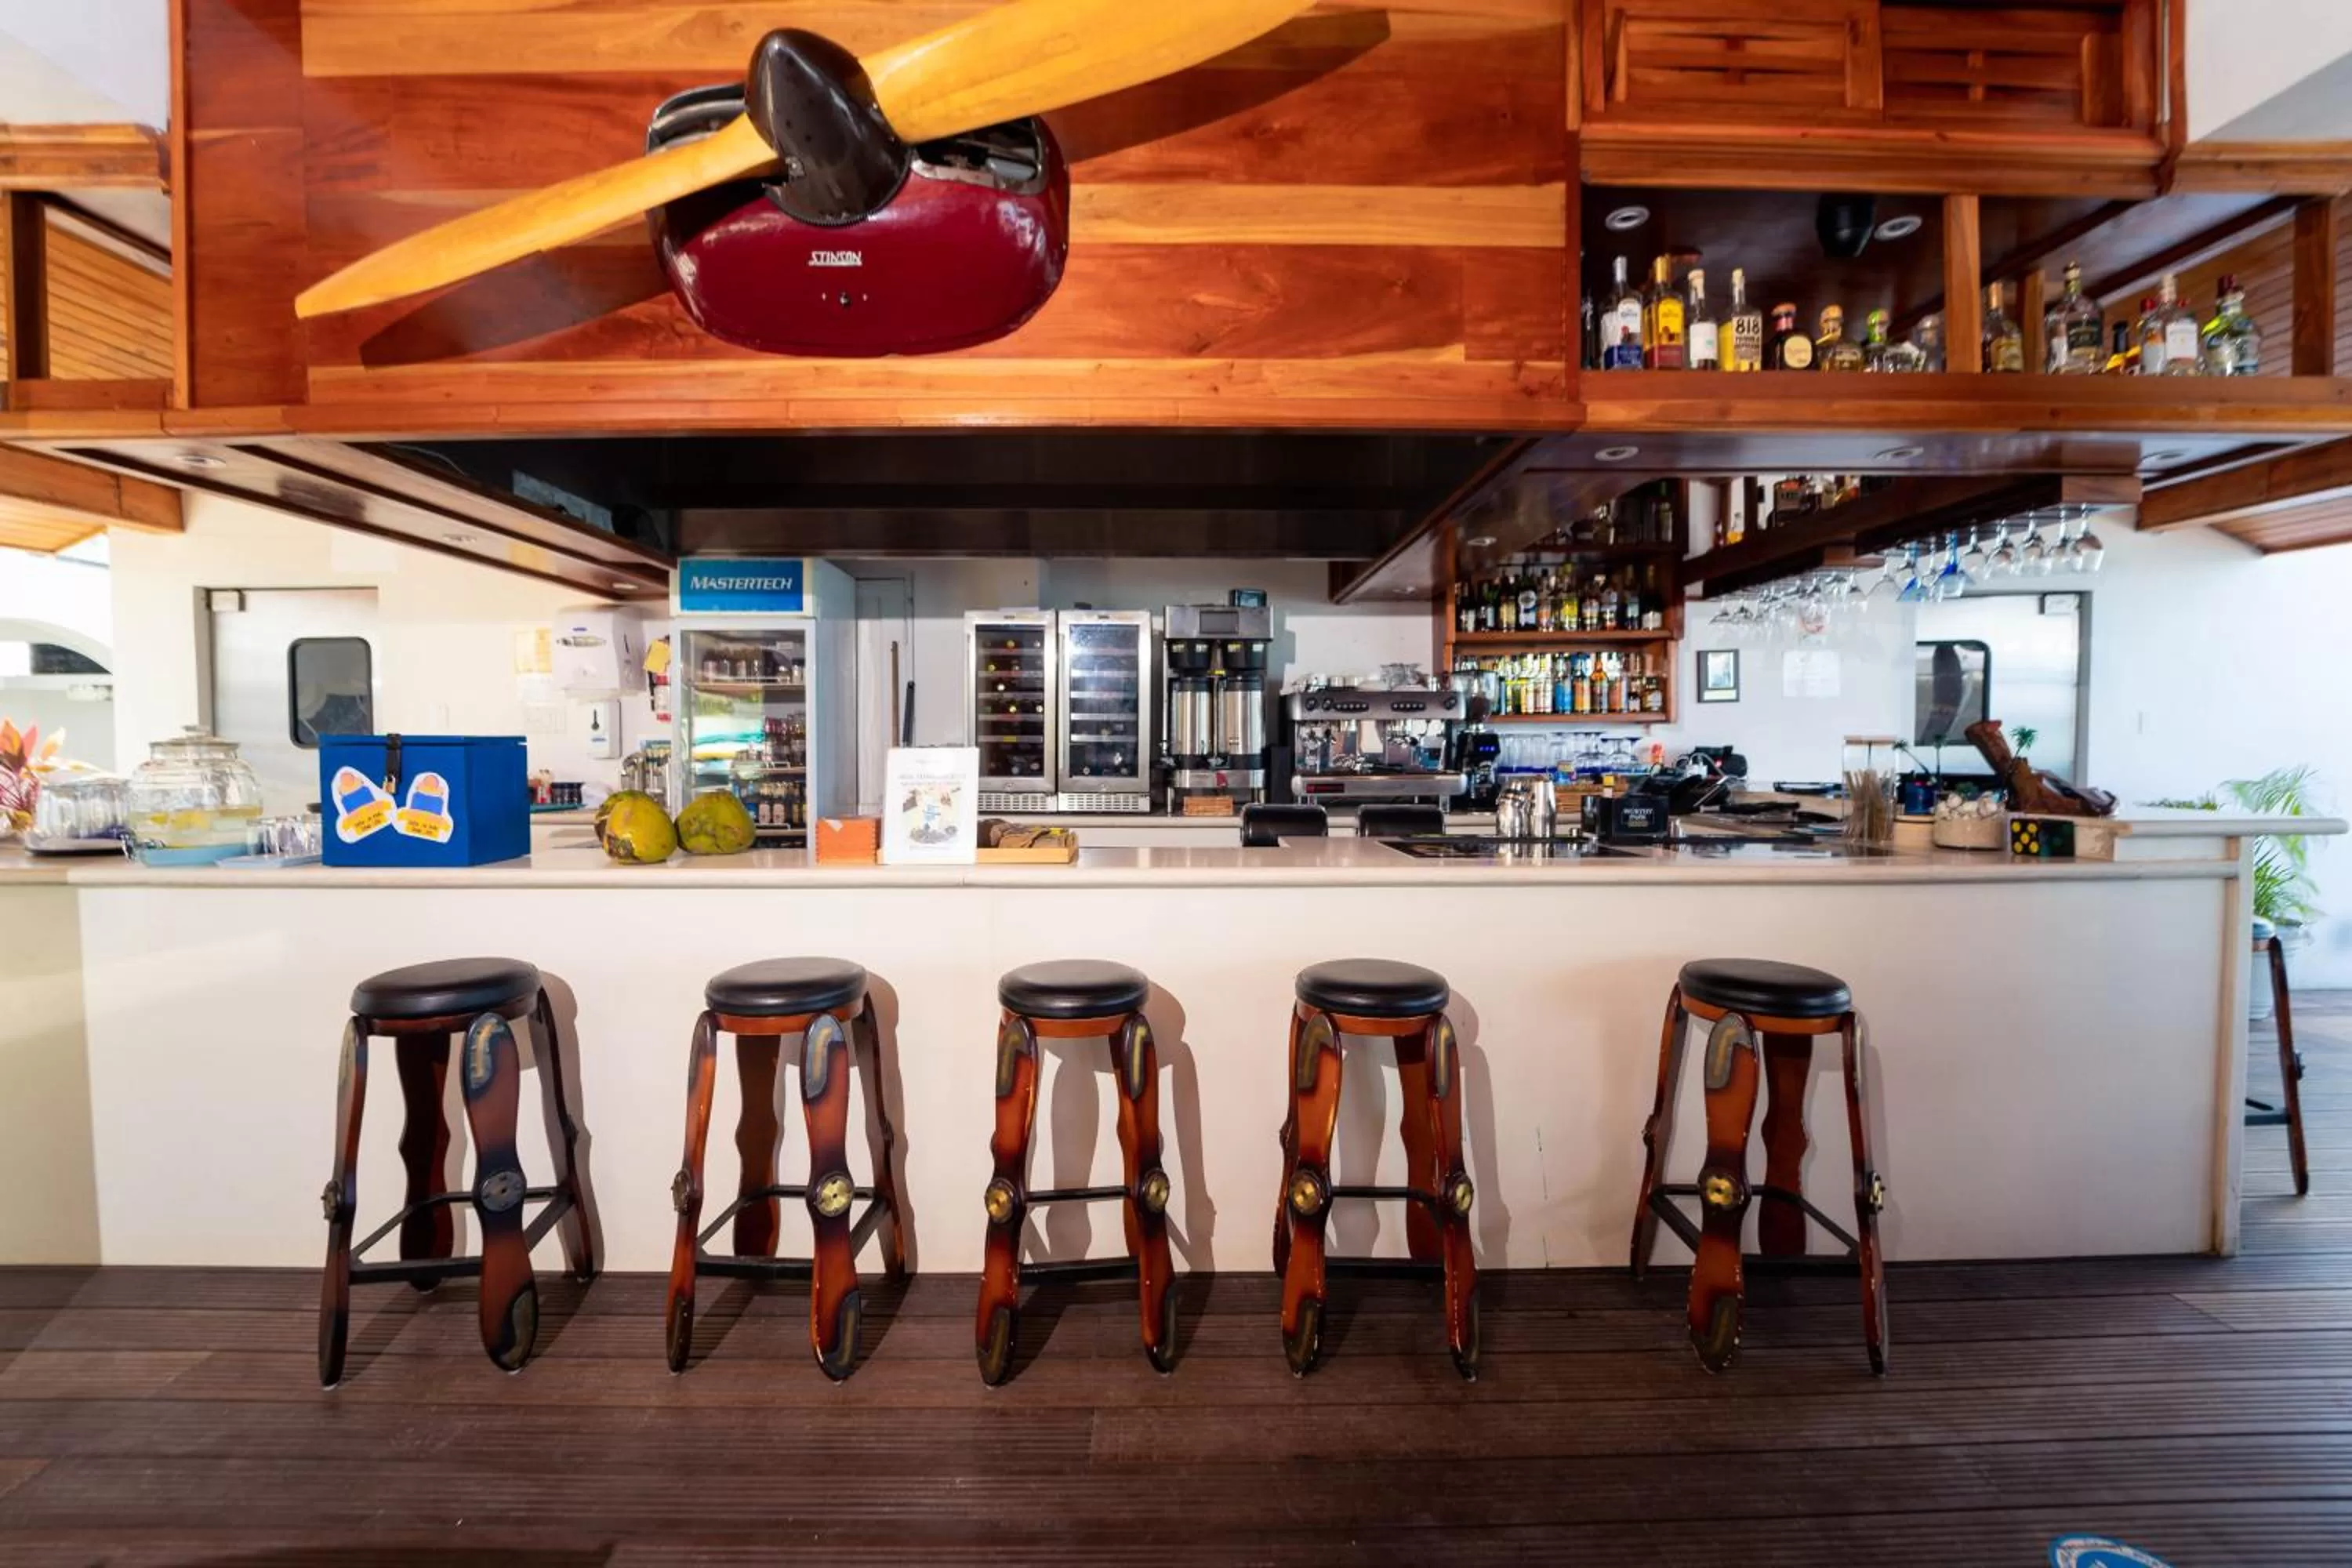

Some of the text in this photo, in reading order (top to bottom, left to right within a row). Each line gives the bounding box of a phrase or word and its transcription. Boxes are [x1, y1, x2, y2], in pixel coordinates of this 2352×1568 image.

[808, 250, 862, 266] STINSON
[1736, 318, 1760, 334] 818
[690, 576, 793, 590] MASTERTECH
